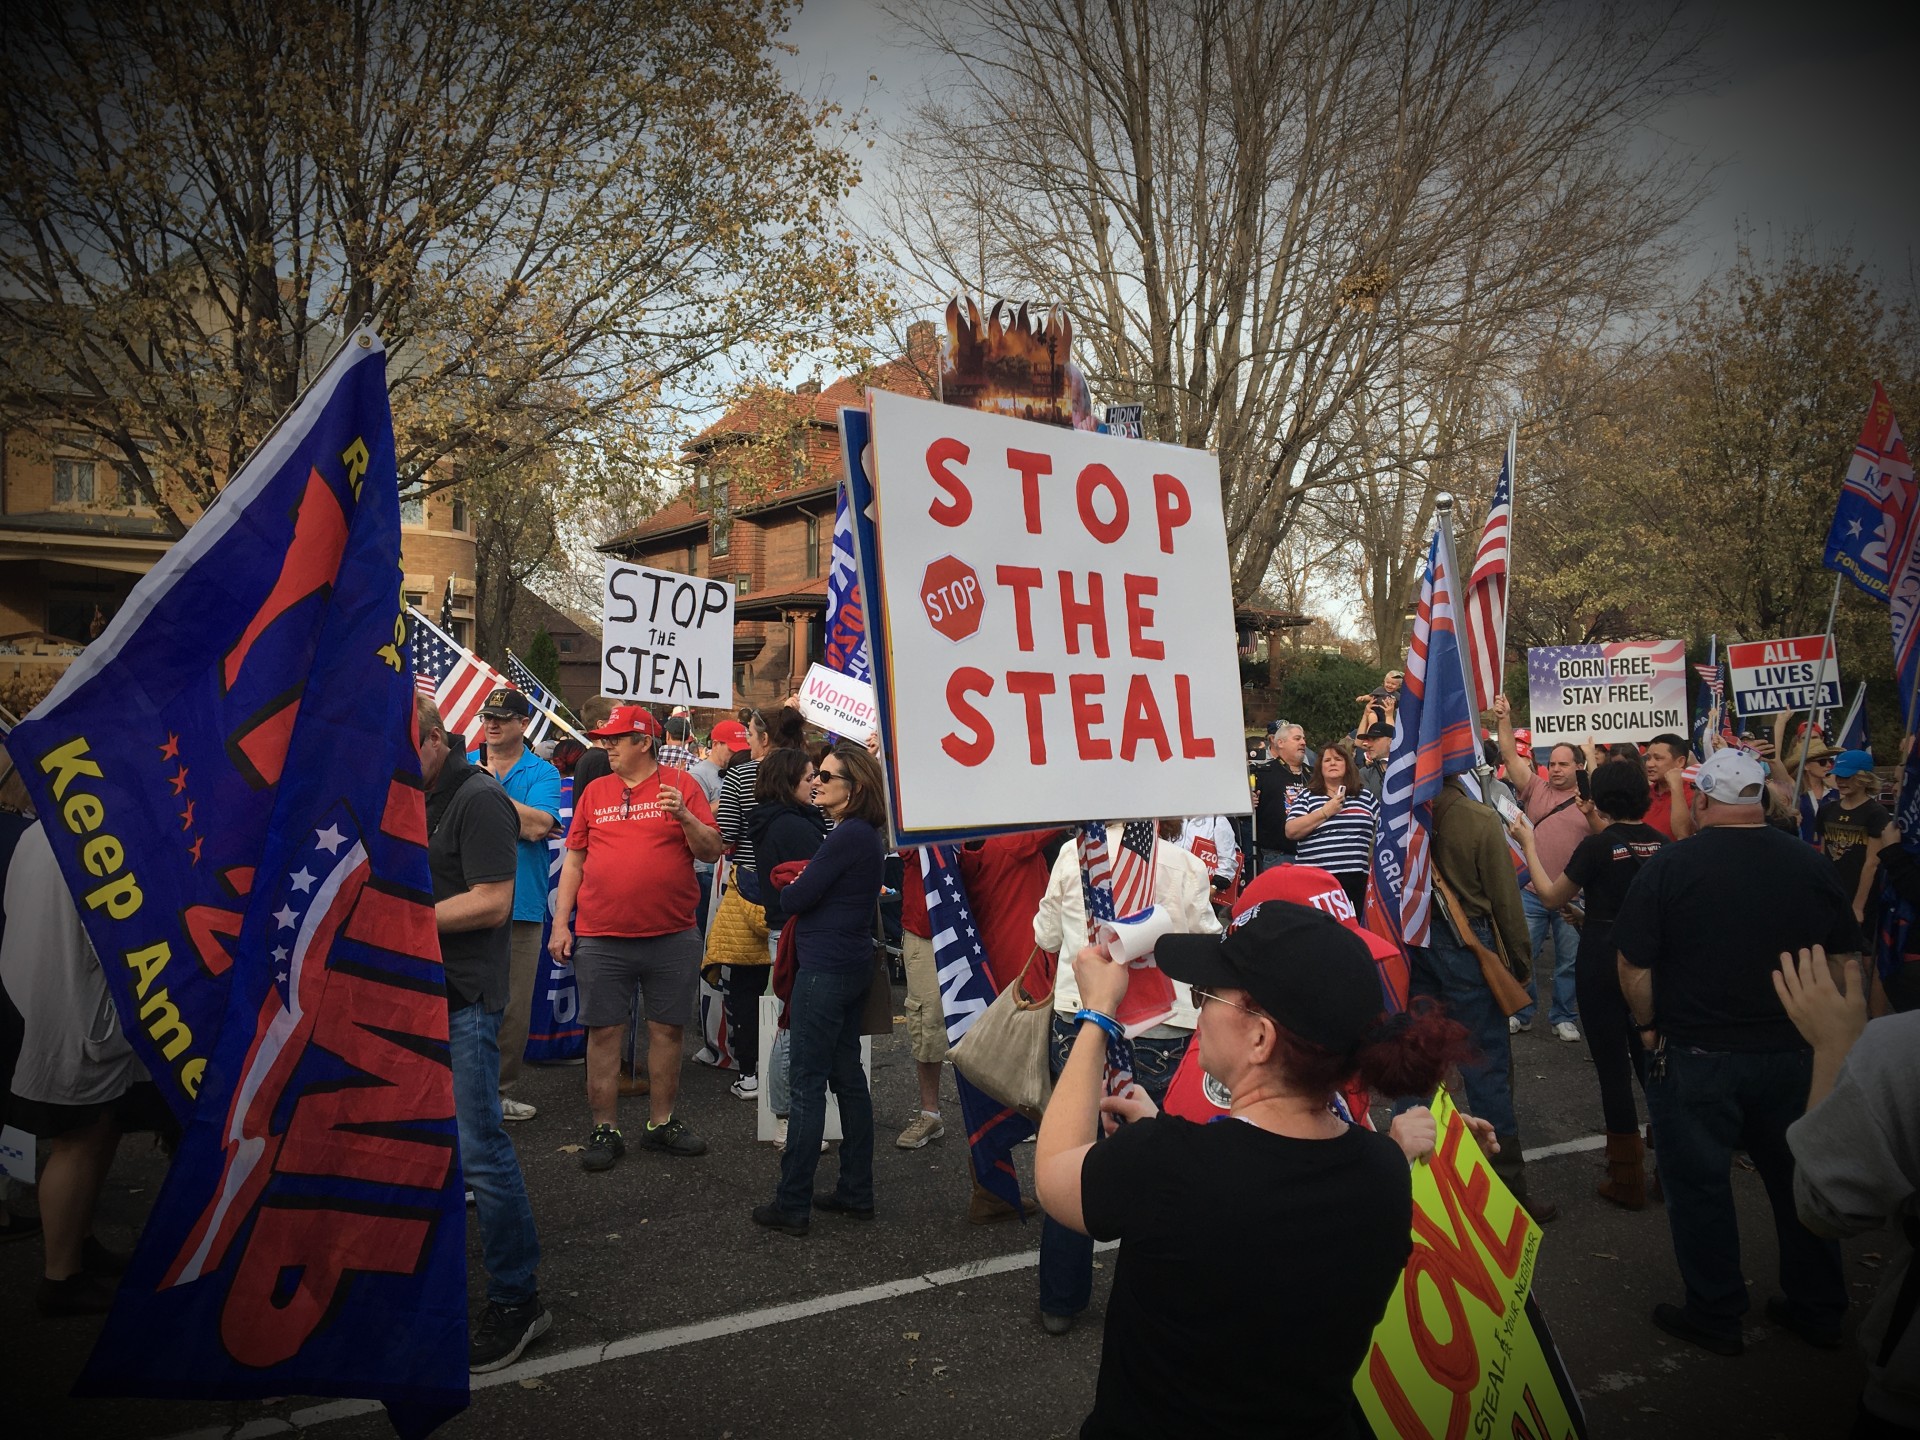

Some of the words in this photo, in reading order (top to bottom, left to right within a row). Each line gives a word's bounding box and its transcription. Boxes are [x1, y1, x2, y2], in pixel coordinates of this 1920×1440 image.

[925, 437, 1192, 554] STOP
[608, 568, 728, 630] STOP
[926, 574, 978, 623] STOP
[996, 564, 1166, 661] THE
[648, 627, 677, 648] THE
[1558, 659, 1606, 680] BORN
[1609, 655, 1656, 679] FREE,
[1763, 642, 1802, 664] ALL
[605, 646, 720, 700] STEAL
[1754, 662, 1814, 688] LIVES
[1562, 686, 1604, 707] STAY
[1607, 682, 1654, 705] FREE,
[1744, 684, 1832, 711] MATTER
[810, 699, 831, 716] FOR
[833, 707, 868, 729] TRUMP
[940, 666, 1216, 767] STEAL
[1535, 712, 1588, 734] NEVER
[1591, 709, 1684, 732] SOCIALISM.
[593, 804, 620, 817] MAKE
[620, 799, 667, 814] AMERIC
[631, 810, 663, 821] AGAIN
[39, 736, 145, 921] Keep
[1503, 1301, 1521, 1342] YOUR
[1514, 1231, 1539, 1300] NEIGHBOR
[1475, 1355, 1511, 1440] STEAL
